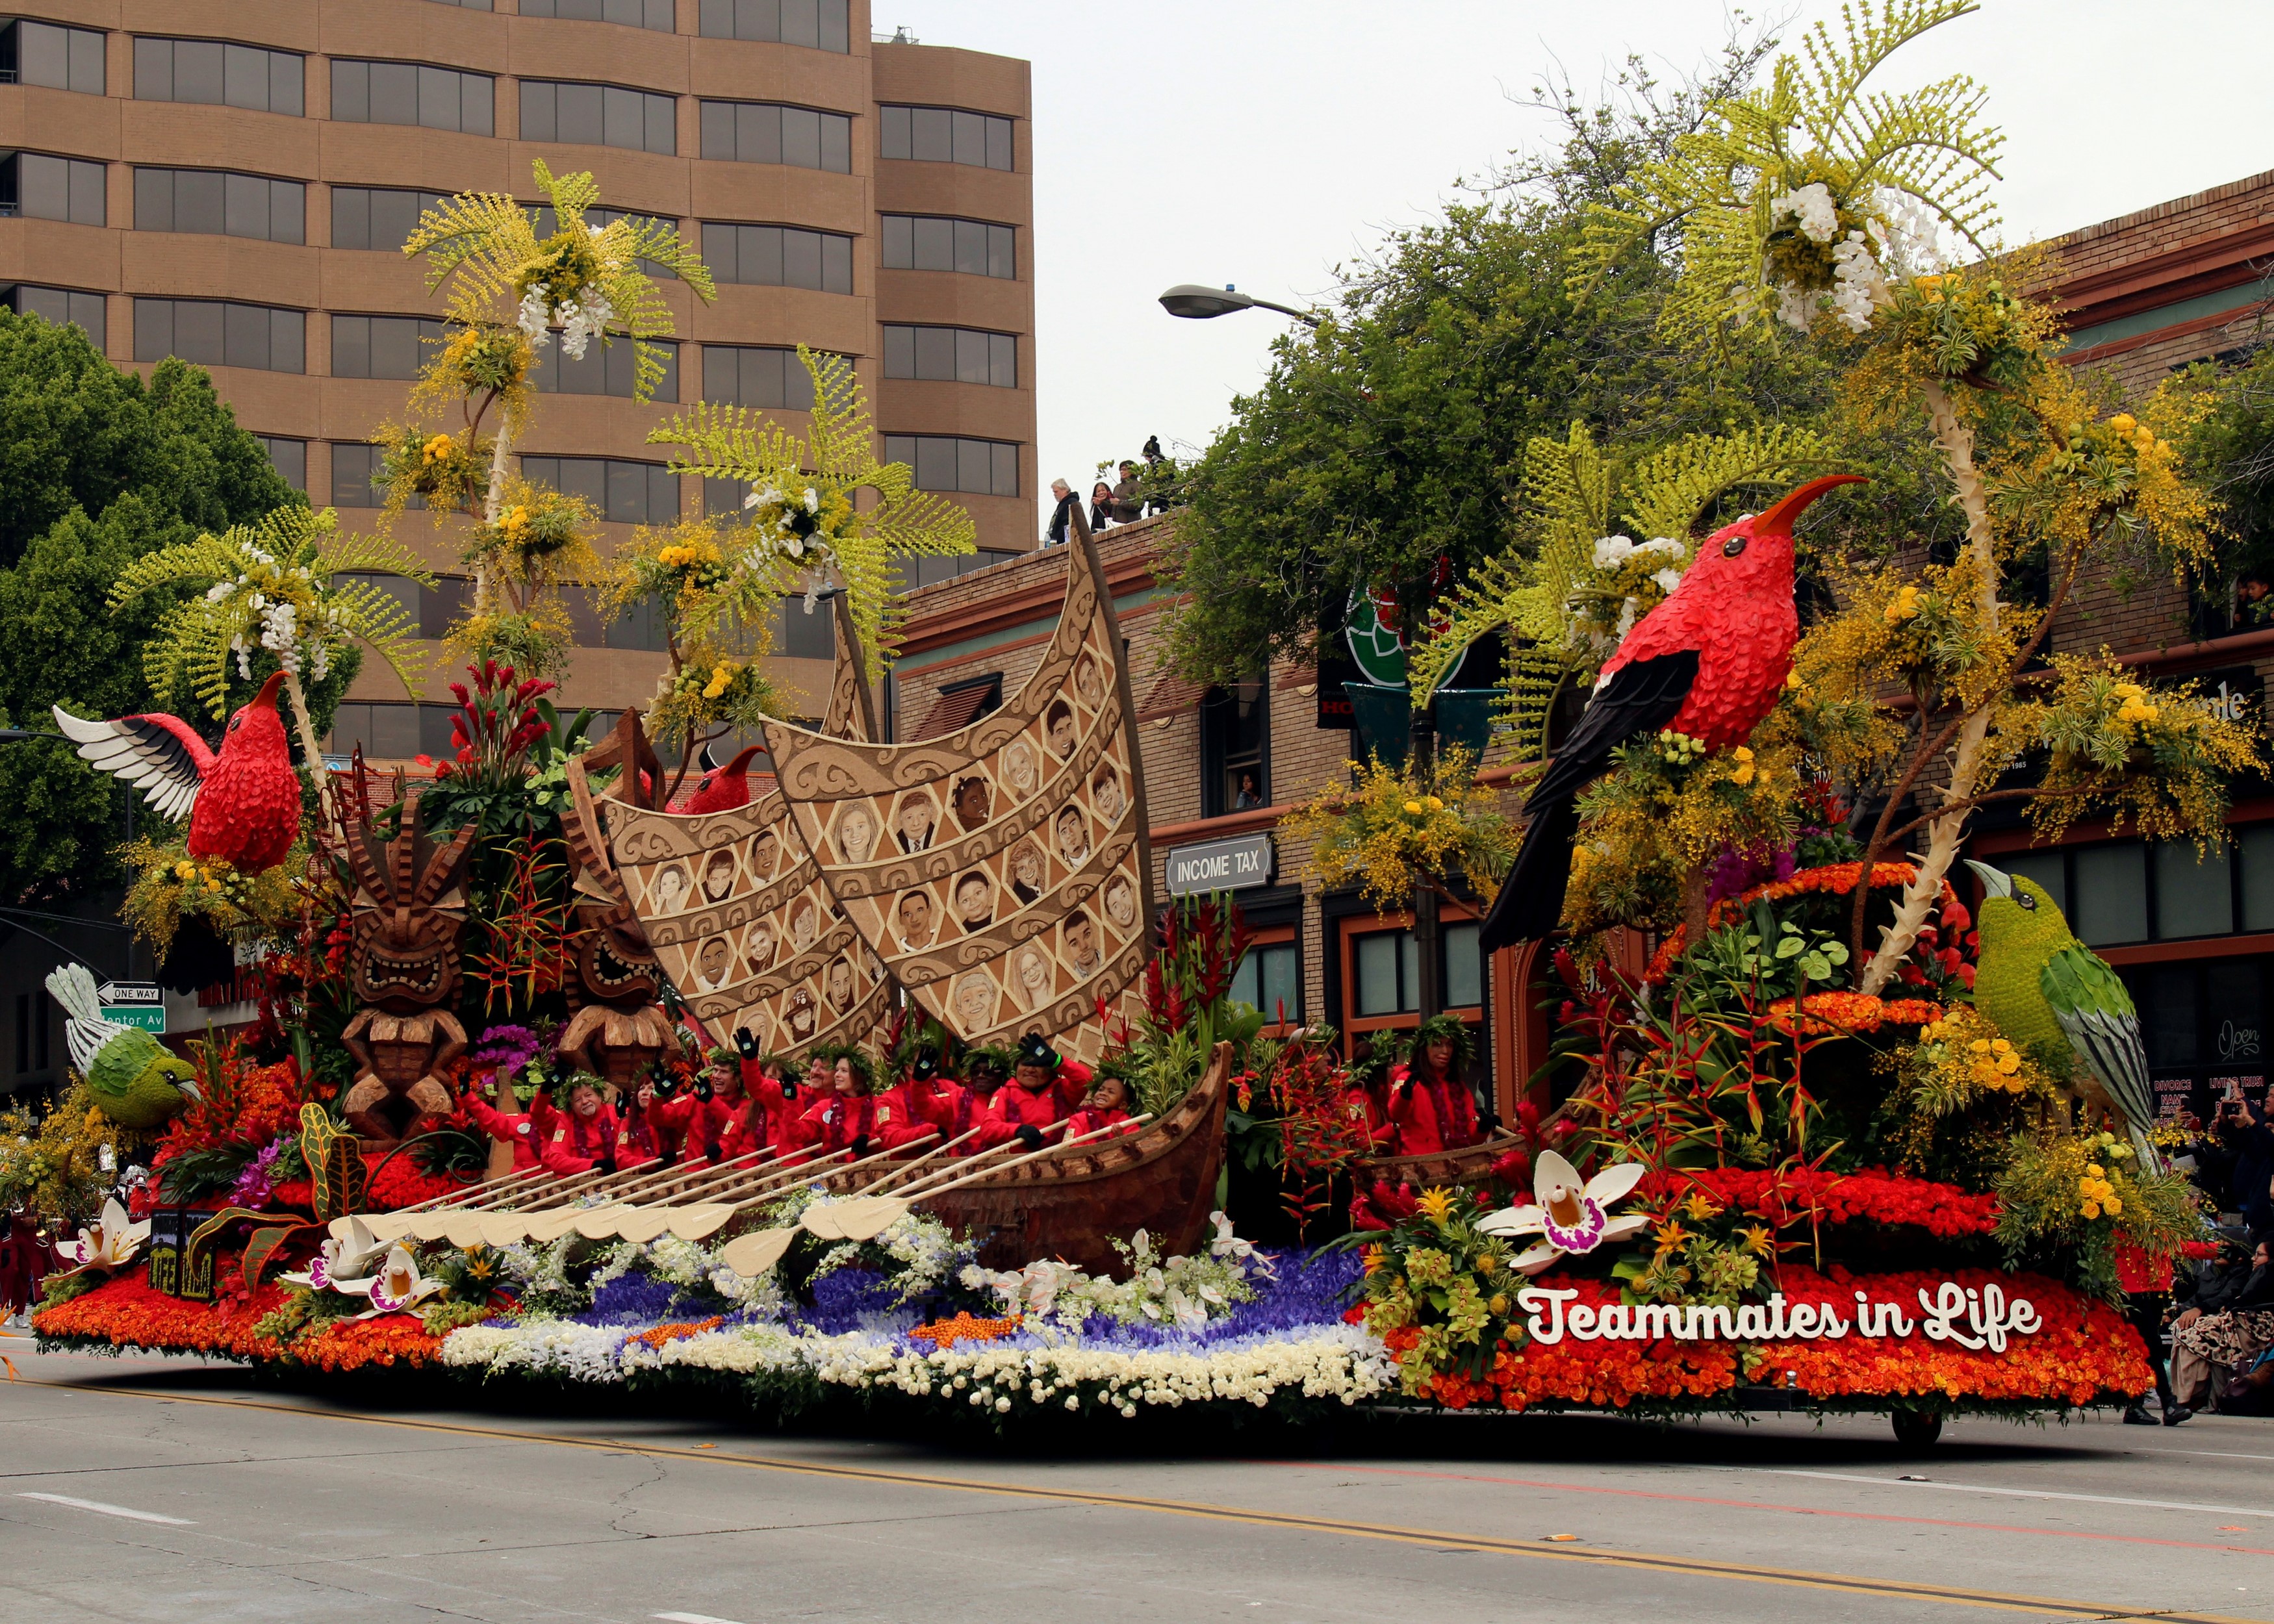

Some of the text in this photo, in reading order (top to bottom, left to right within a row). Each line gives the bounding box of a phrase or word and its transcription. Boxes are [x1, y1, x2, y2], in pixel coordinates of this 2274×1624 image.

[2012, 761, 2026, 770] 1985
[1178, 850, 1258, 882] INCOME TAX
[114, 989, 155, 998] ONE WAY
[147, 1015, 162, 1025] Av
[2218, 1020, 2260, 1060] Open
[2154, 1079, 2192, 1091] DIVORCE
[2240, 1075, 2265, 1087] TRUST
[2160, 1093, 2184, 1106] NAM
[2159, 1106, 2177, 1115] CHA
[1517, 1282, 2042, 1353] Teammates in Life
